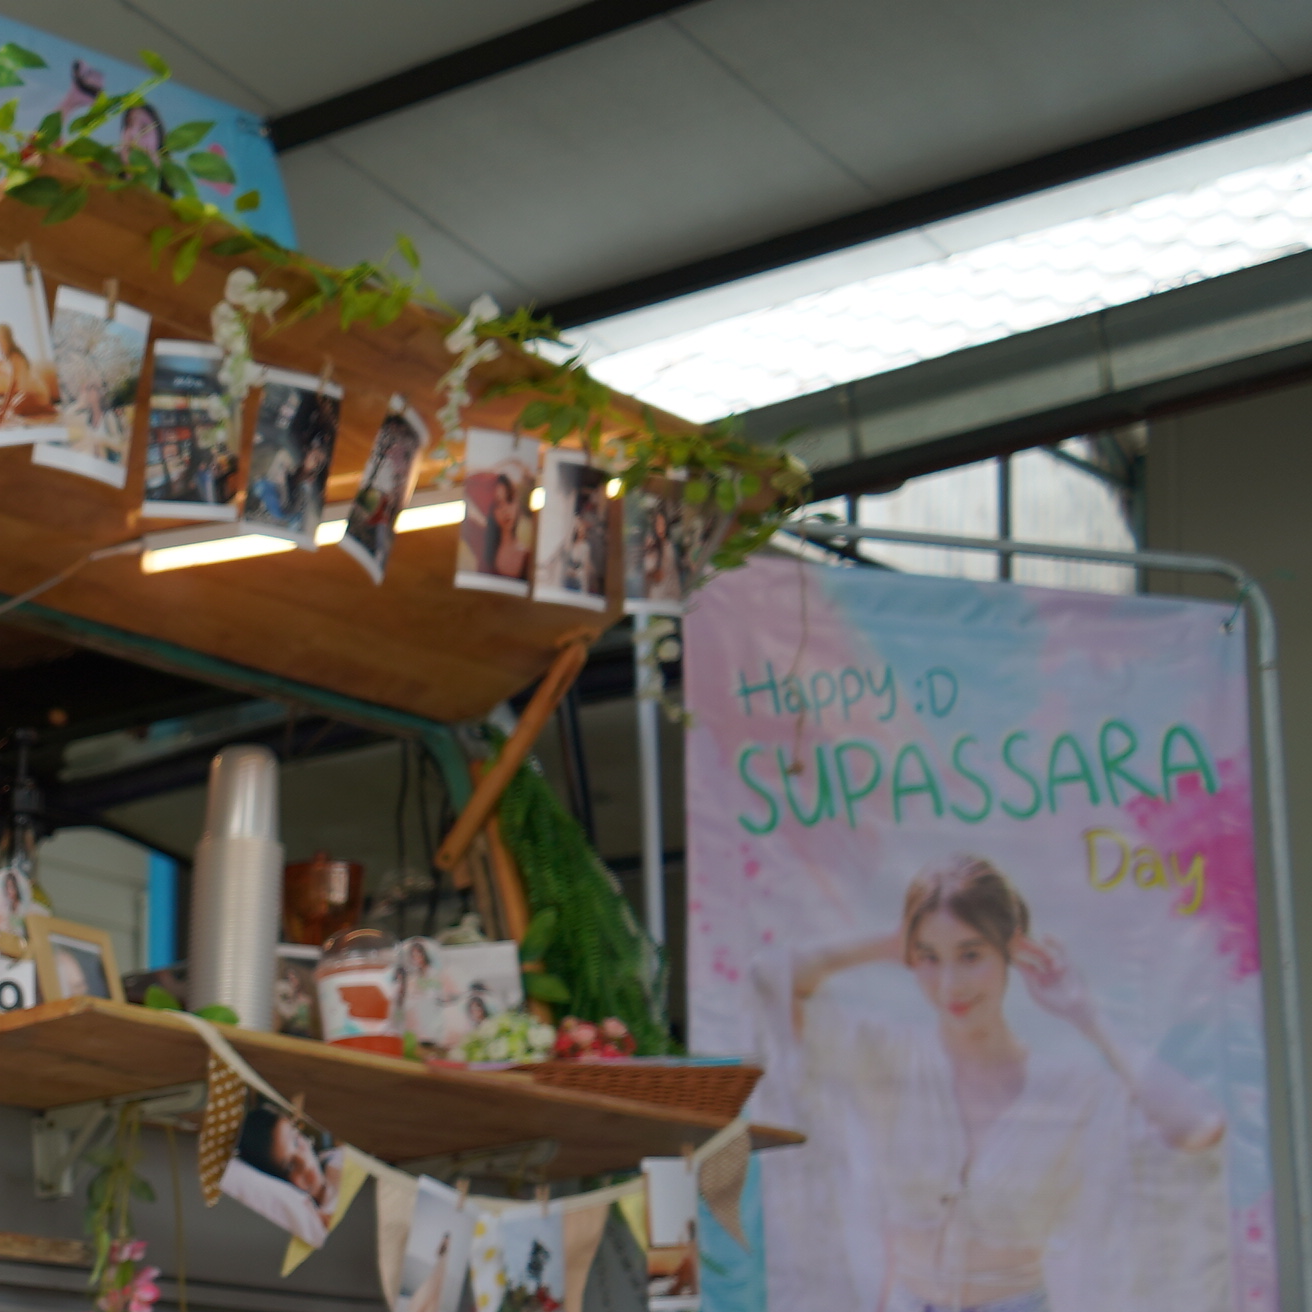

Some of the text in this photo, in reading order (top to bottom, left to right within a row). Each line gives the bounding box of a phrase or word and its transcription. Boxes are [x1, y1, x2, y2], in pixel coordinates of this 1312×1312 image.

[738, 662, 959, 725] Happy :D
[737, 718, 1220, 836] SUPASSARA
[1084, 828, 1207, 916] Day
